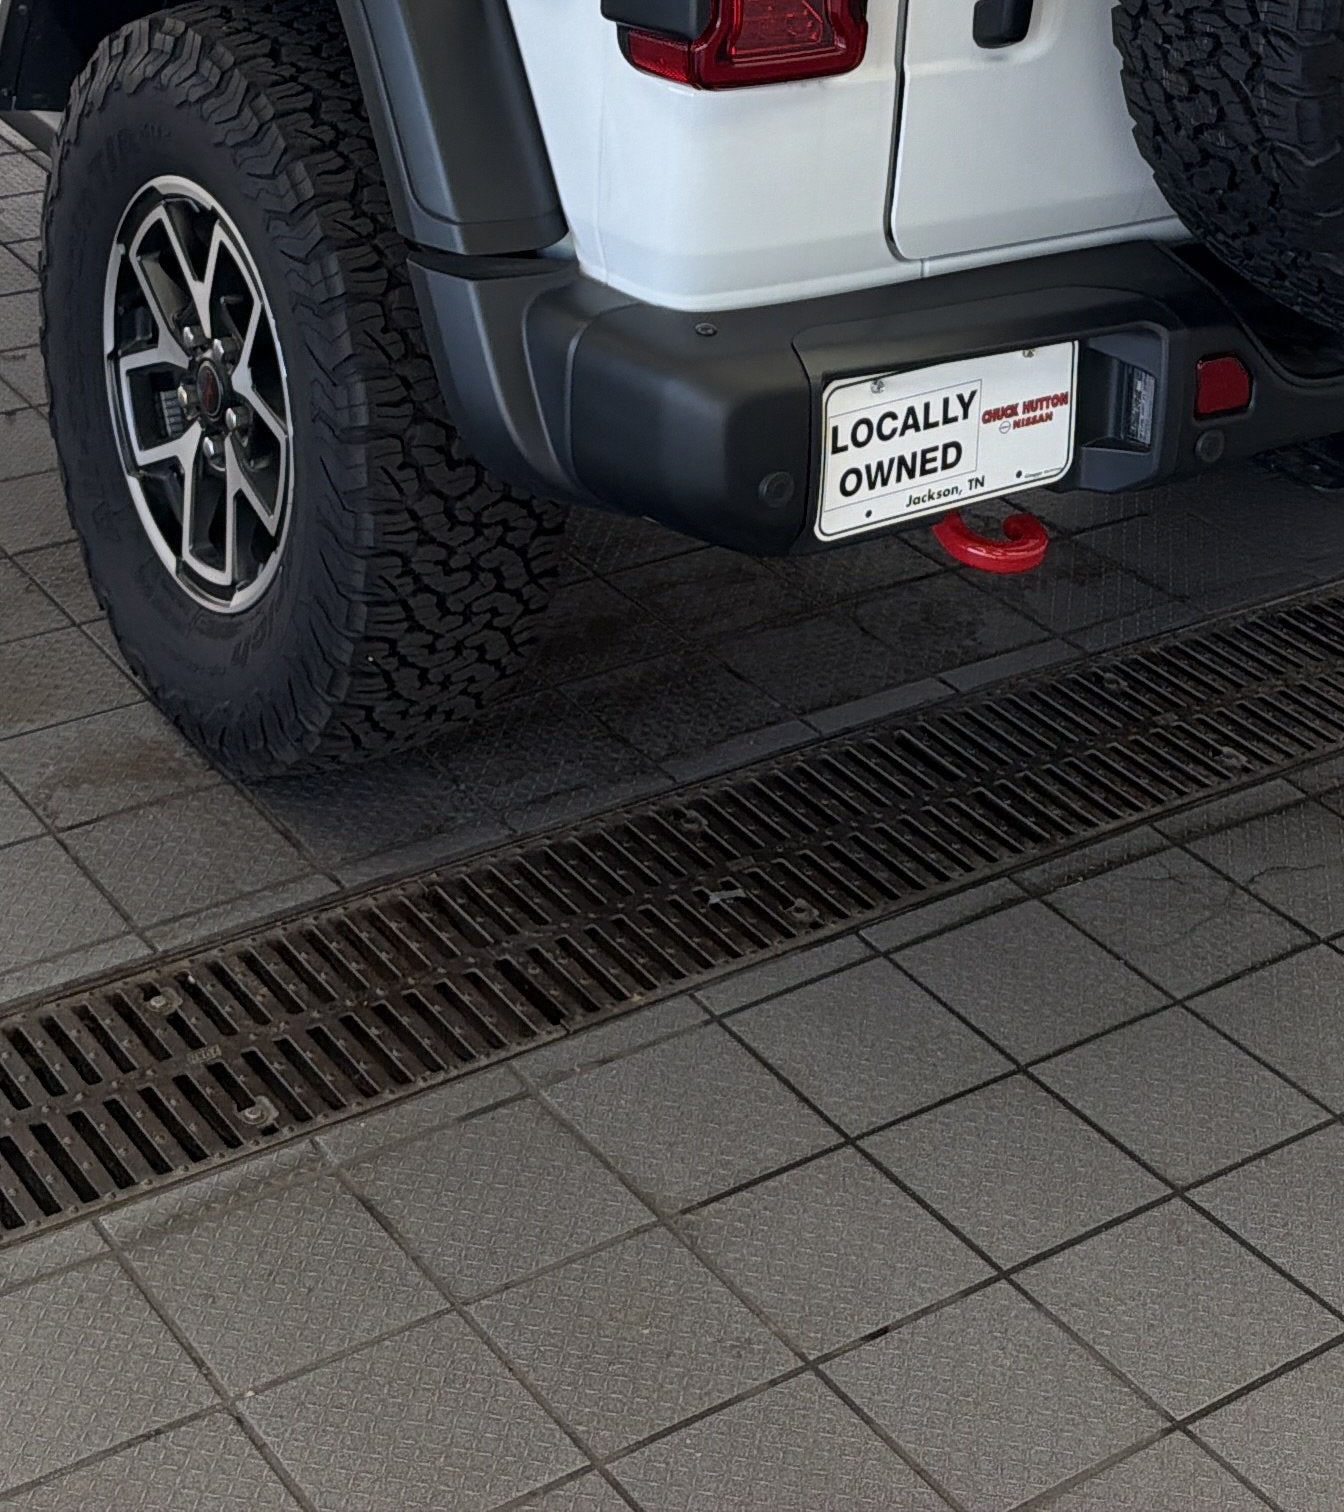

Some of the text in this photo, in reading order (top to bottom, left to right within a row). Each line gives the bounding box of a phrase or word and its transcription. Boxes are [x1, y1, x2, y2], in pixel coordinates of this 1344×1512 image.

[830, 389, 978, 456] LOCALLY
[981, 390, 1070, 425] CHUCK HUTTON
[1012, 410, 1054, 431] NISSAN
[839, 440, 964, 499] OWNED
[905, 474, 986, 508] Jackson, TN
